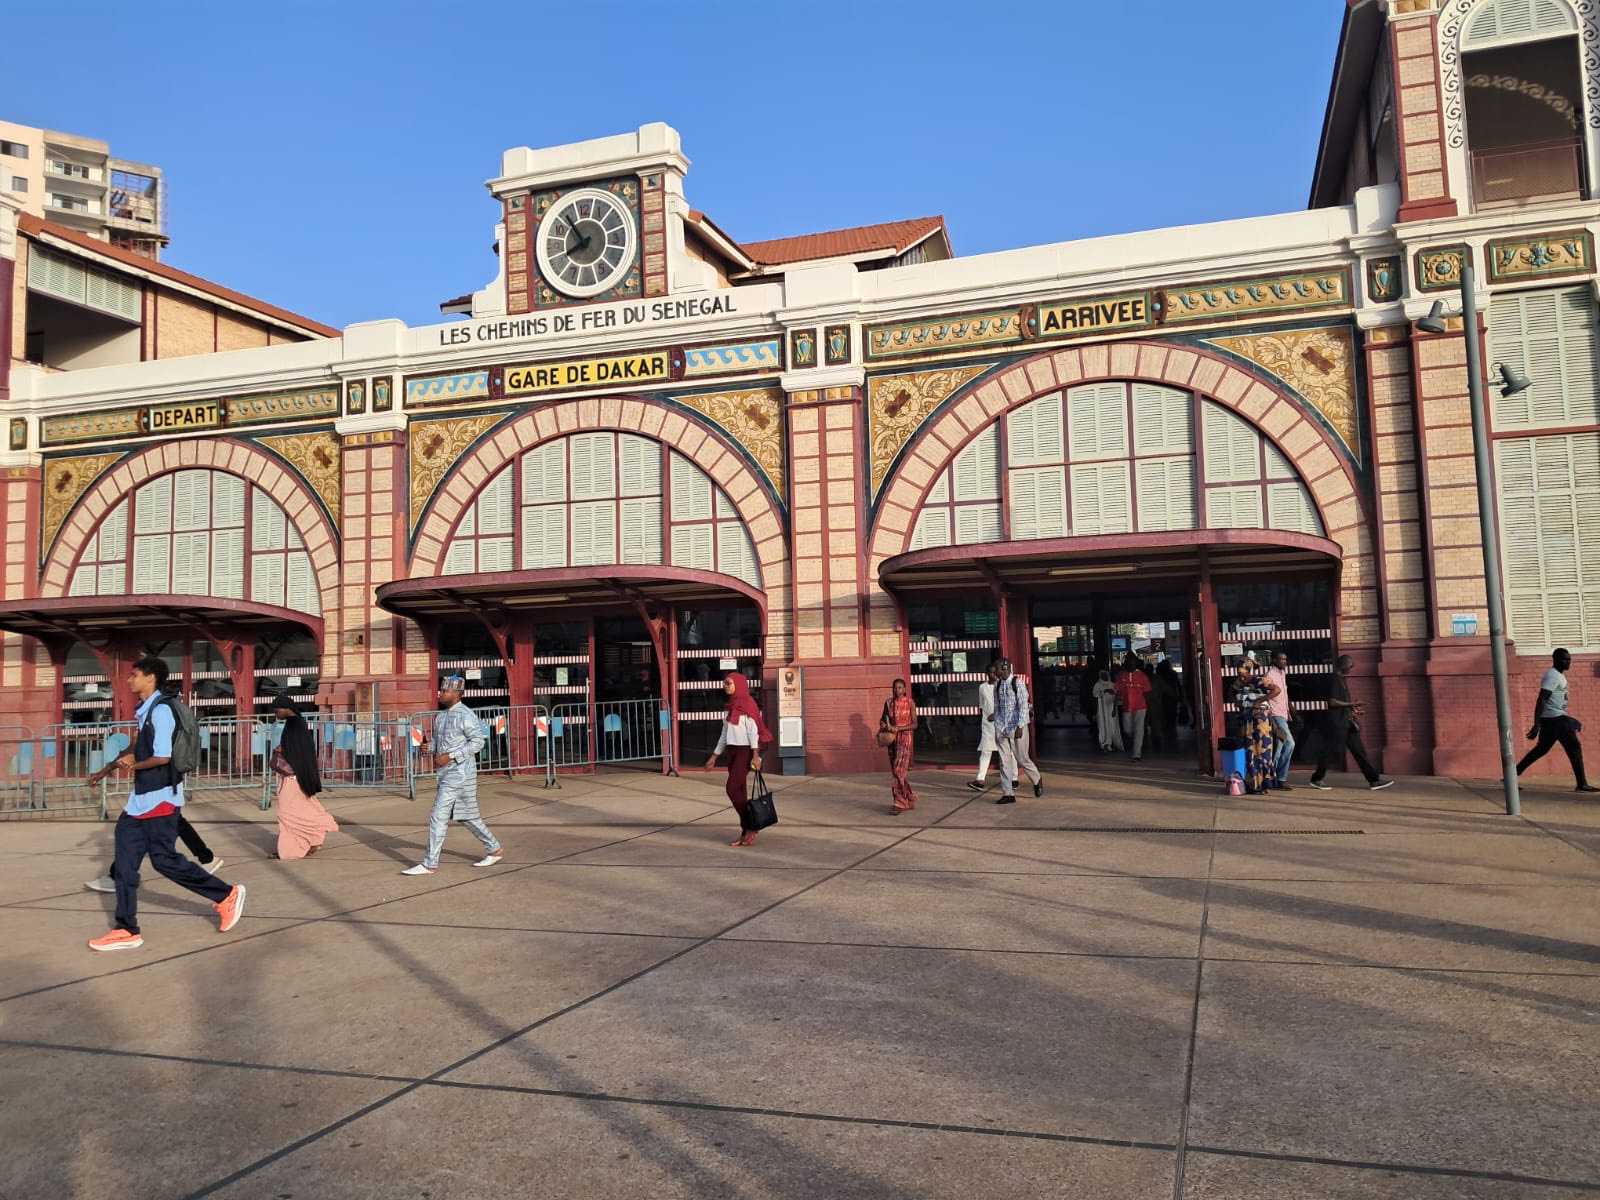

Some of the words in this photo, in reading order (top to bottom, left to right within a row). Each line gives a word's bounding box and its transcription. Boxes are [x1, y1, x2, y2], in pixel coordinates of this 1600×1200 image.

[579, 204, 590, 216] 12
[555, 225, 565, 234] 10
[612, 234, 619, 242] 3
[598, 263, 605, 275] 5
[440, 327, 471, 346] LES
[477, 317, 548, 341] CHEMINS
[553, 314, 576, 333] DE
[581, 309, 616, 330] FER
[623, 305, 645, 324] DU
[652, 295, 737, 321] SENEGAL
[1043, 299, 1144, 331] ARRIVEE
[508, 367, 560, 389] GARE
[567, 364, 590, 384] DE
[597, 356, 664, 381] DAKAR
[153, 405, 217, 428] DEPART
